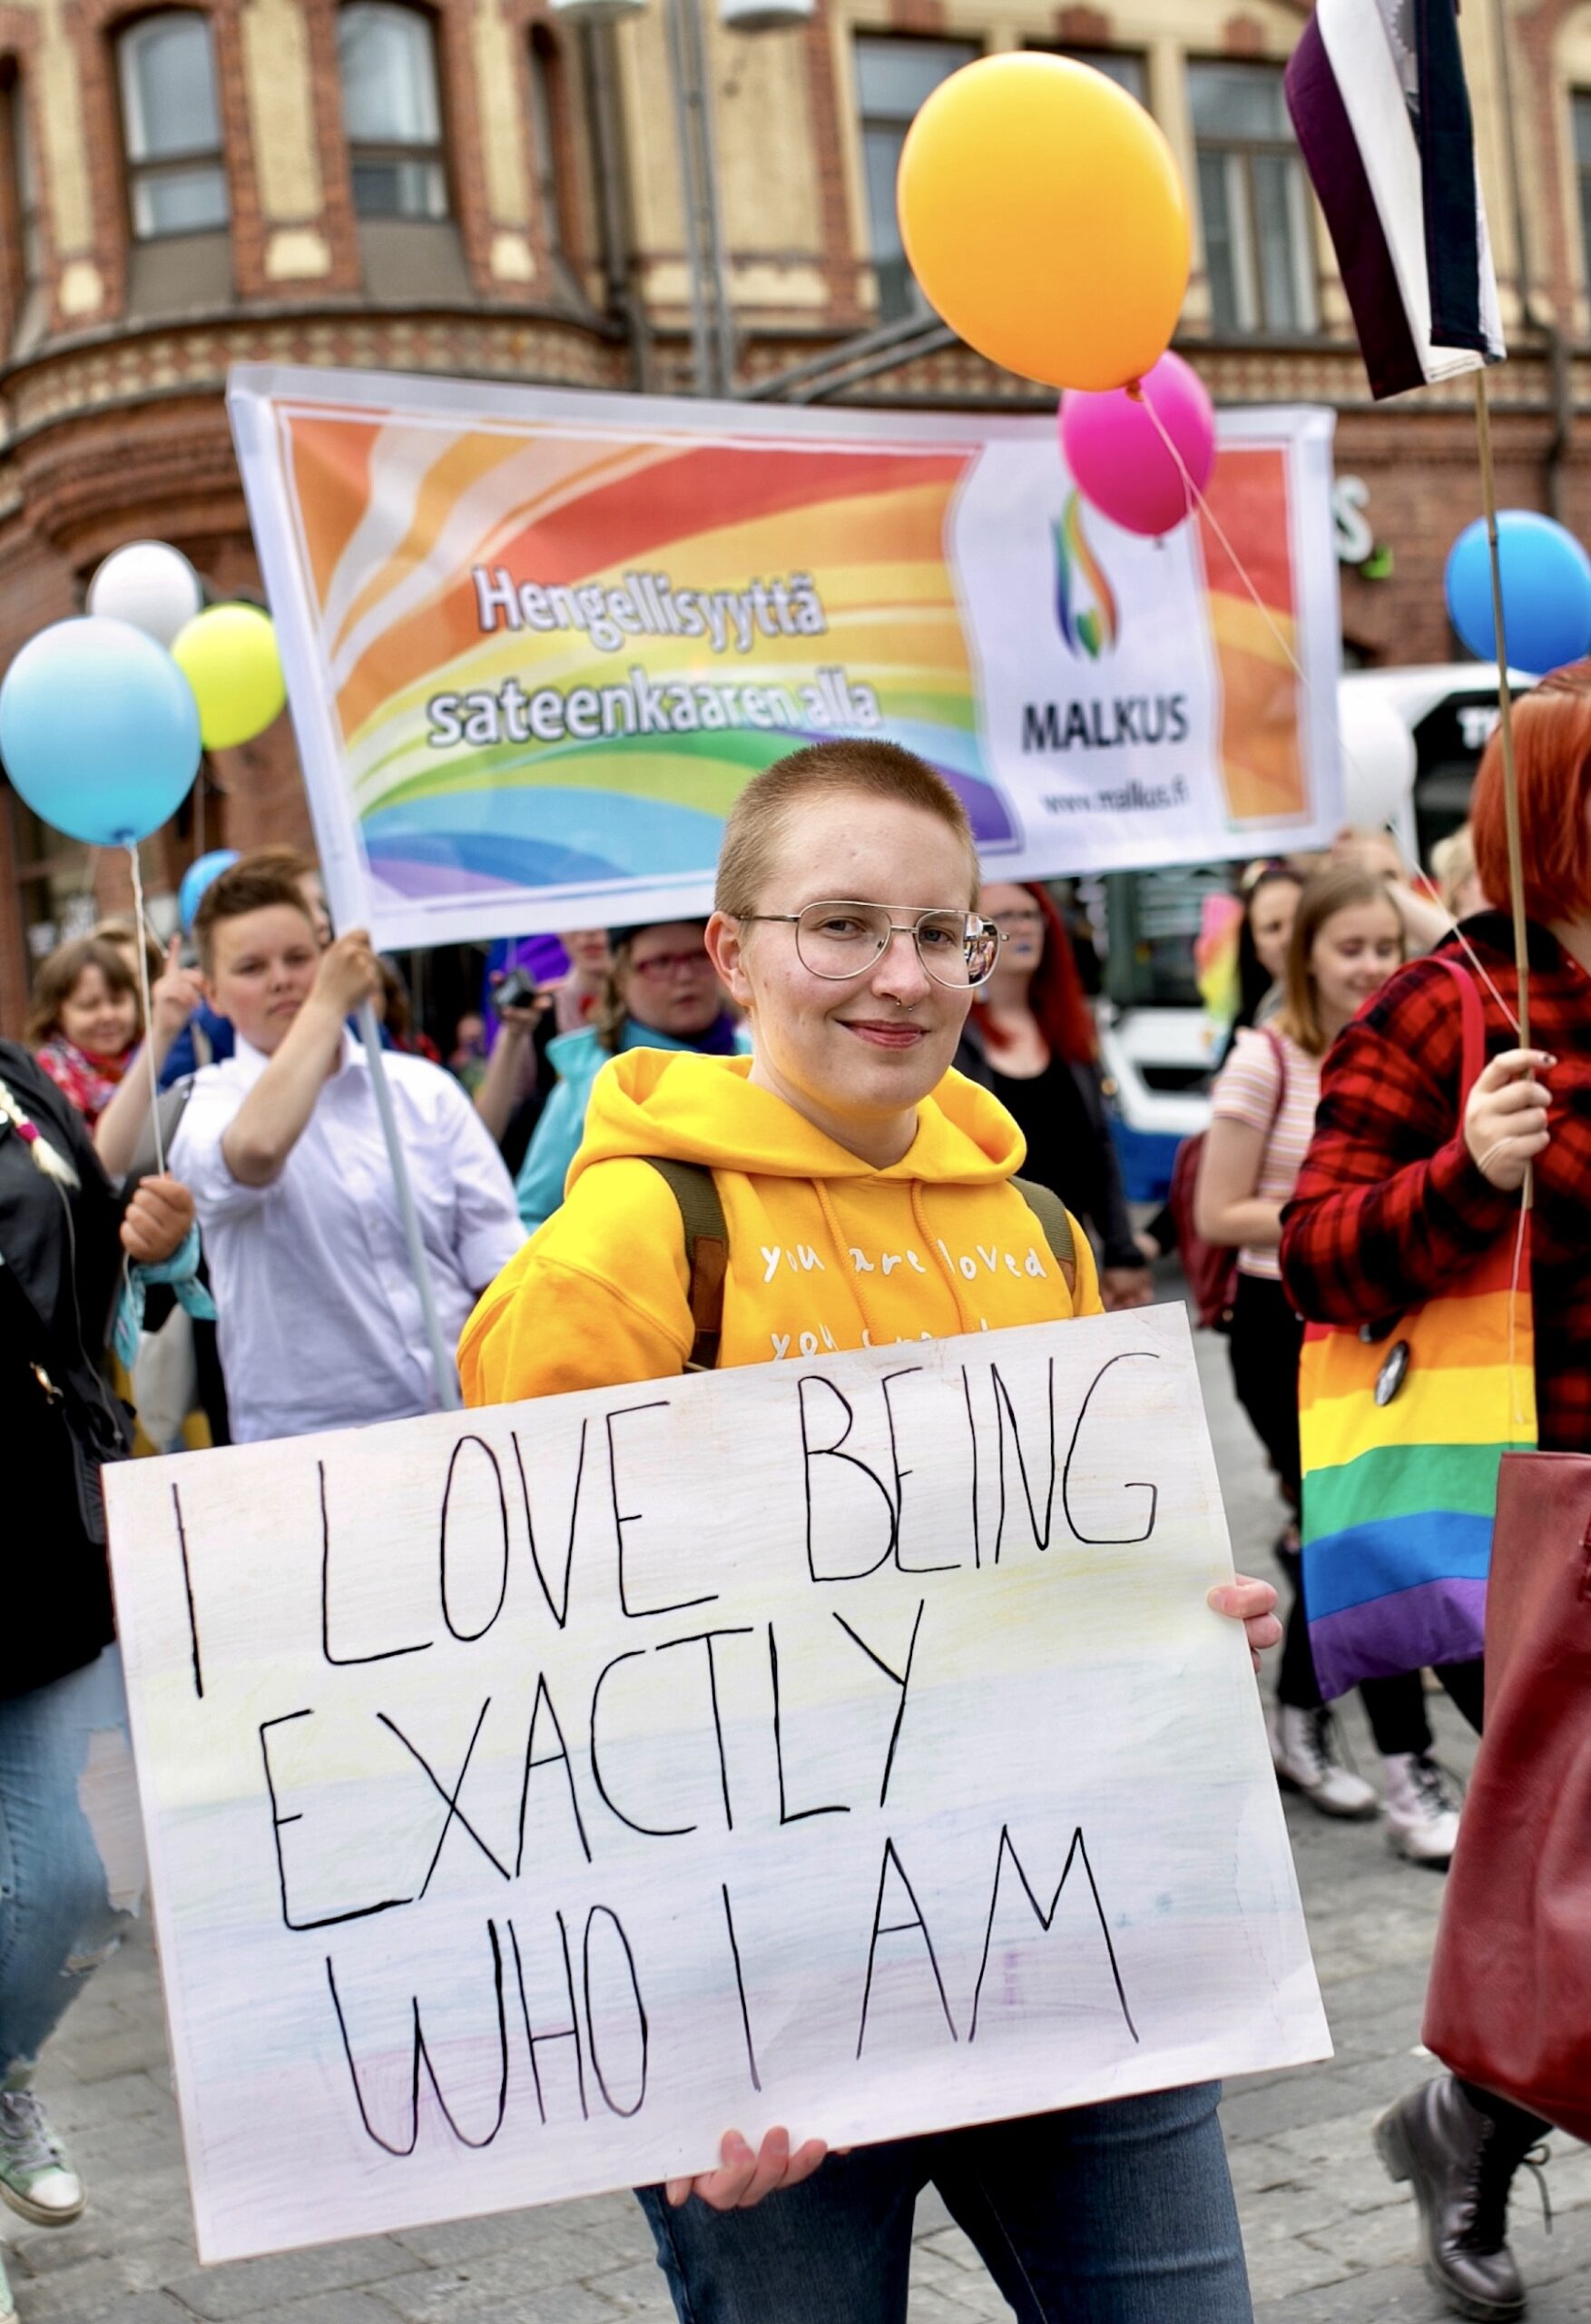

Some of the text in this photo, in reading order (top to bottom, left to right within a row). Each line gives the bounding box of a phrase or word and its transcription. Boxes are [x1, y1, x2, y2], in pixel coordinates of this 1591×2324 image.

[472, 565, 827, 652] Hengellisyyttä
[427, 664, 880, 746] sateenkaaren alla
[1022, 694, 1190, 753] MALKUS
[1042, 775, 1190, 813] www.malkus.fi
[761, 1238, 1047, 1283] you are loved
[172, 1352, 1161, 1699] I LOVE BEING
[259, 1599, 924, 1931] EXACTLY
[326, 1824, 1140, 2157] WHO I AM
